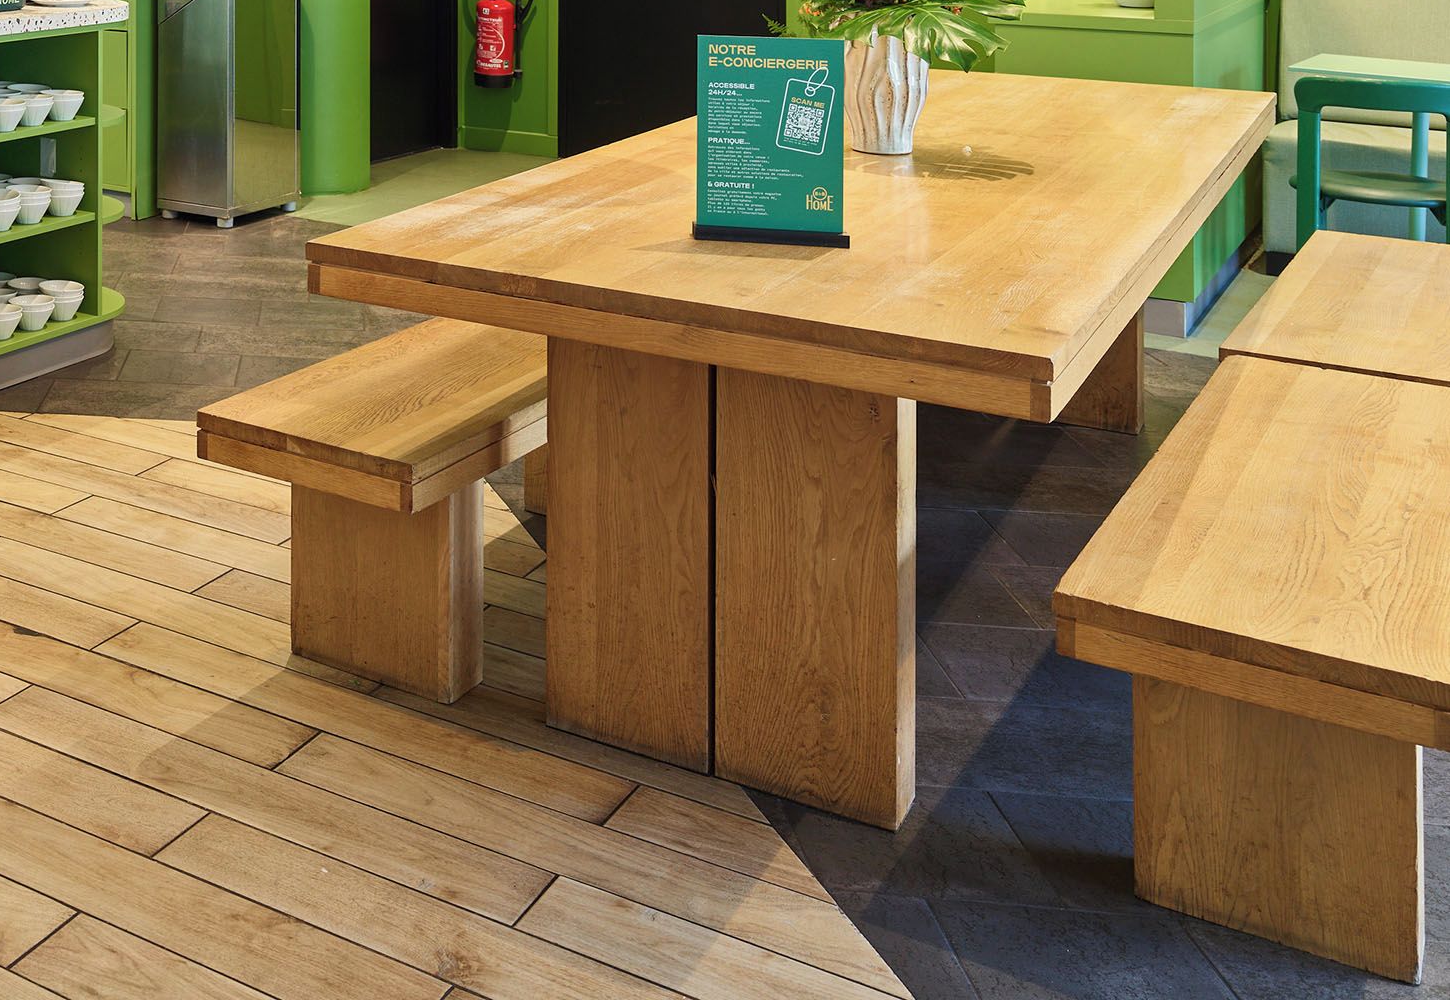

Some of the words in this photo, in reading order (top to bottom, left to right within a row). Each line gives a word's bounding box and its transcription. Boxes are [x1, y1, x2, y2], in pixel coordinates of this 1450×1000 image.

[708, 43, 756, 55] NOTRE
[708, 56, 829, 70] E-CONCIERGERIE
[708, 81, 755, 90] ACCESSIBLE
[790, 96, 813, 106] SCAN
[813, 101, 826, 109] ME
[714, 181, 751, 189] GRATUITE
[806, 194, 834, 211] HOME
